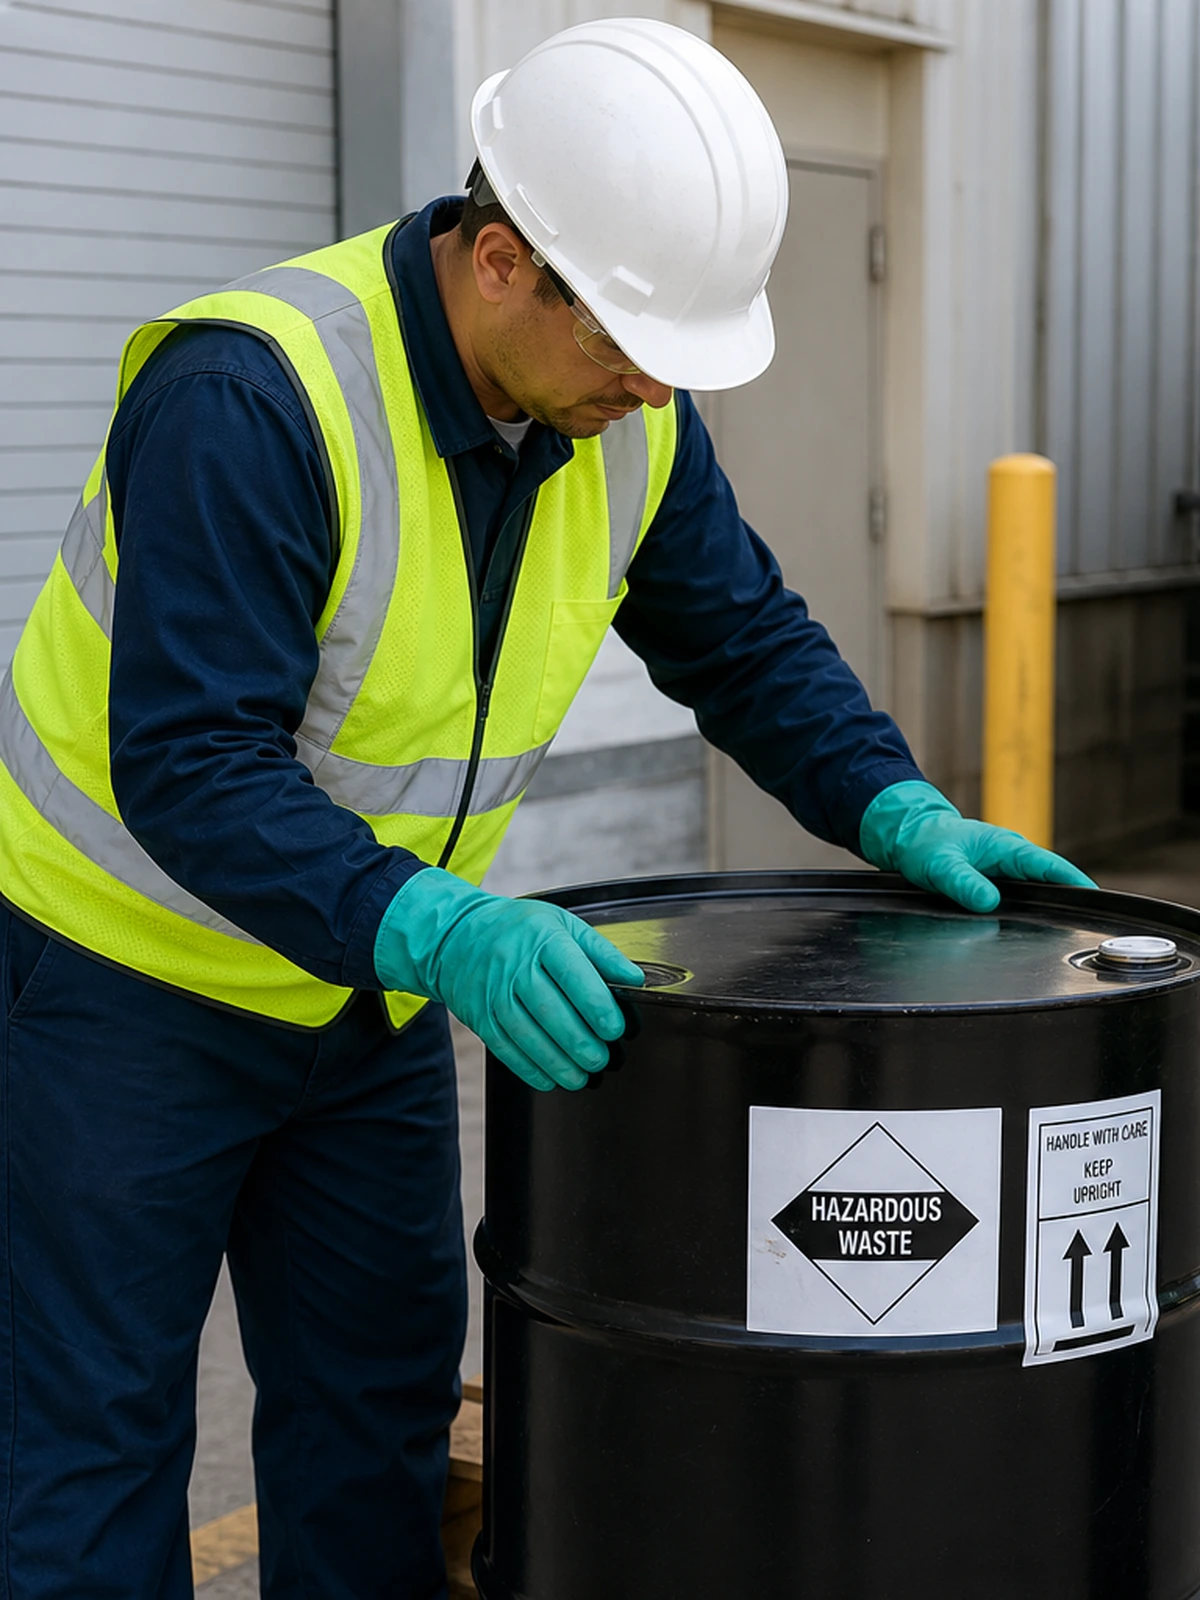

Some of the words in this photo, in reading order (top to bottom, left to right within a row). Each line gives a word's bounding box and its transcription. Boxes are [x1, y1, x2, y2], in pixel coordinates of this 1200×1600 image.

[1092, 1127, 1120, 1146] WITH
[1121, 1120, 1149, 1141] CARE
[1083, 1158, 1114, 1179] KEEP
[1073, 1180, 1123, 1204] UPRIGHT
[811, 1196, 942, 1222] HAZARDOUS
[838, 1230, 912, 1256] WASTE
